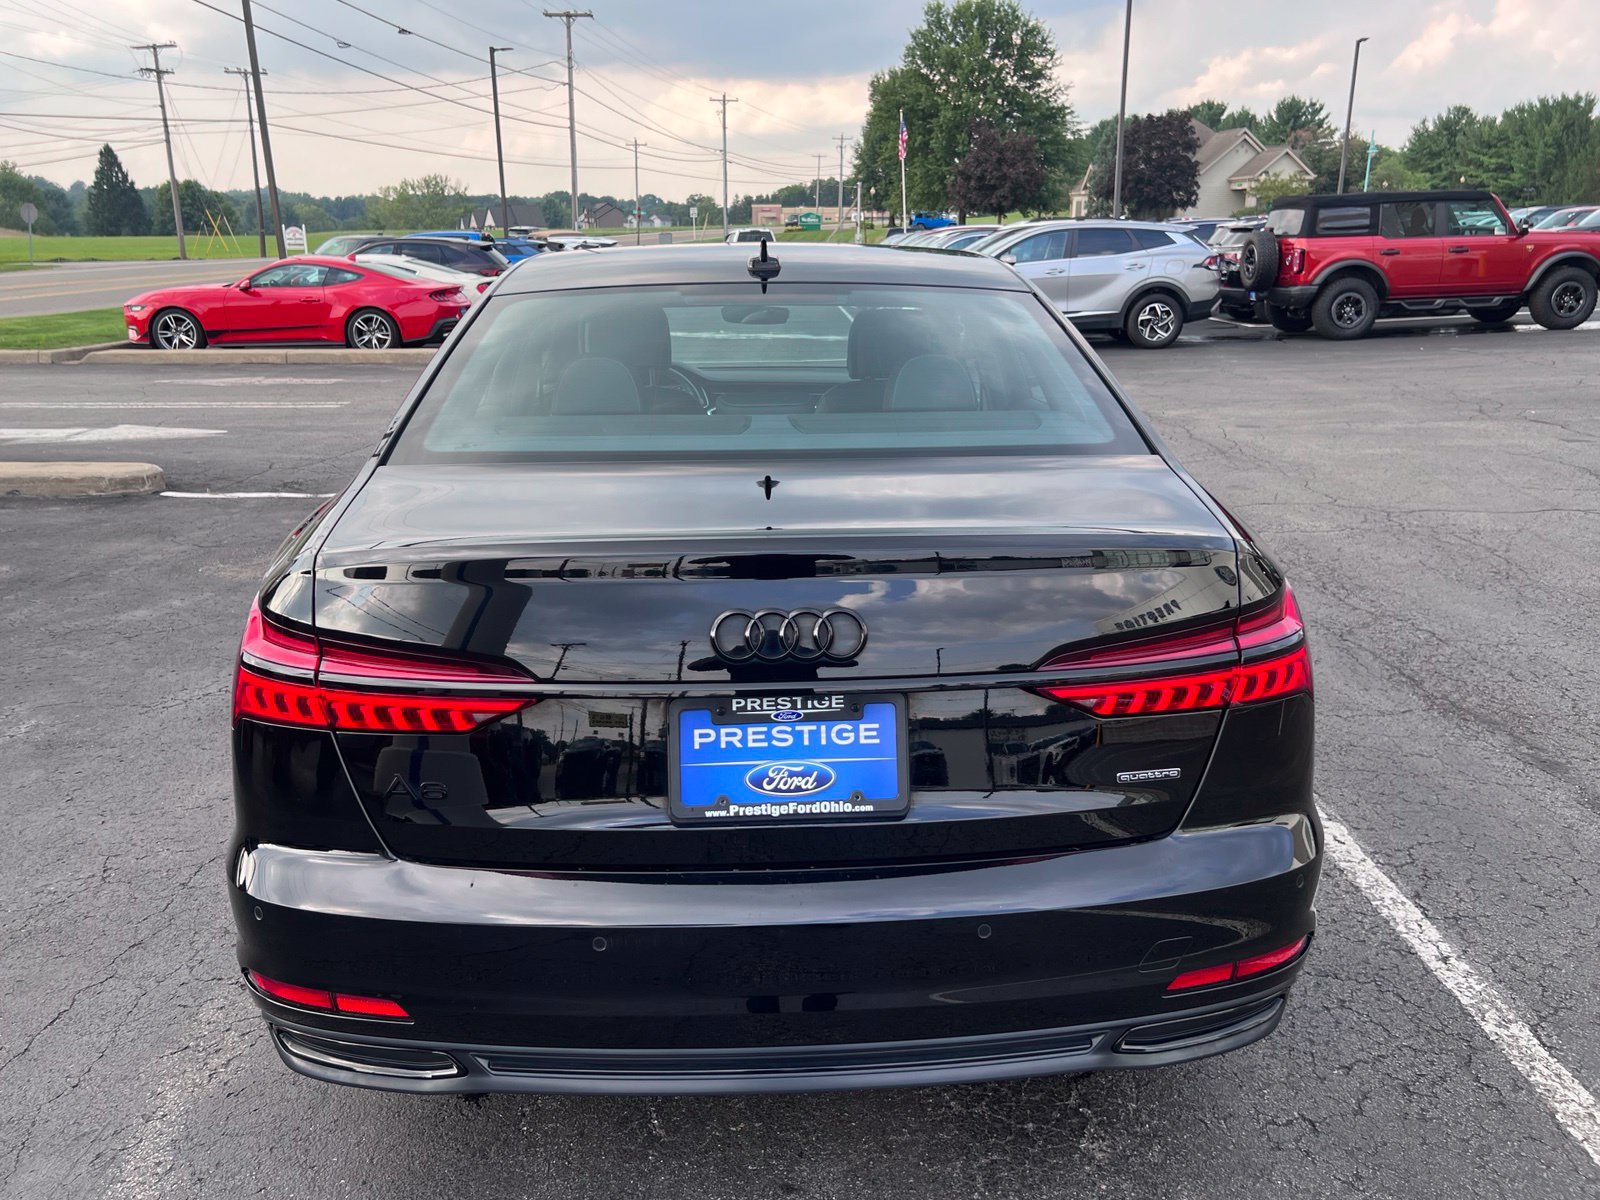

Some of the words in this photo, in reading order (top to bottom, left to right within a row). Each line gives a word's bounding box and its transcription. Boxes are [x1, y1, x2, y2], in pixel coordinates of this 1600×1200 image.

[731, 695, 845, 711] PRESTIGE
[693, 723, 880, 749] PRESTIGE
[384, 773, 448, 799] A6
[762, 765, 818, 790] Ford
[1120, 770, 1178, 782] quattro
[704, 801, 874, 818] www.PrestigeFordOhio.com
